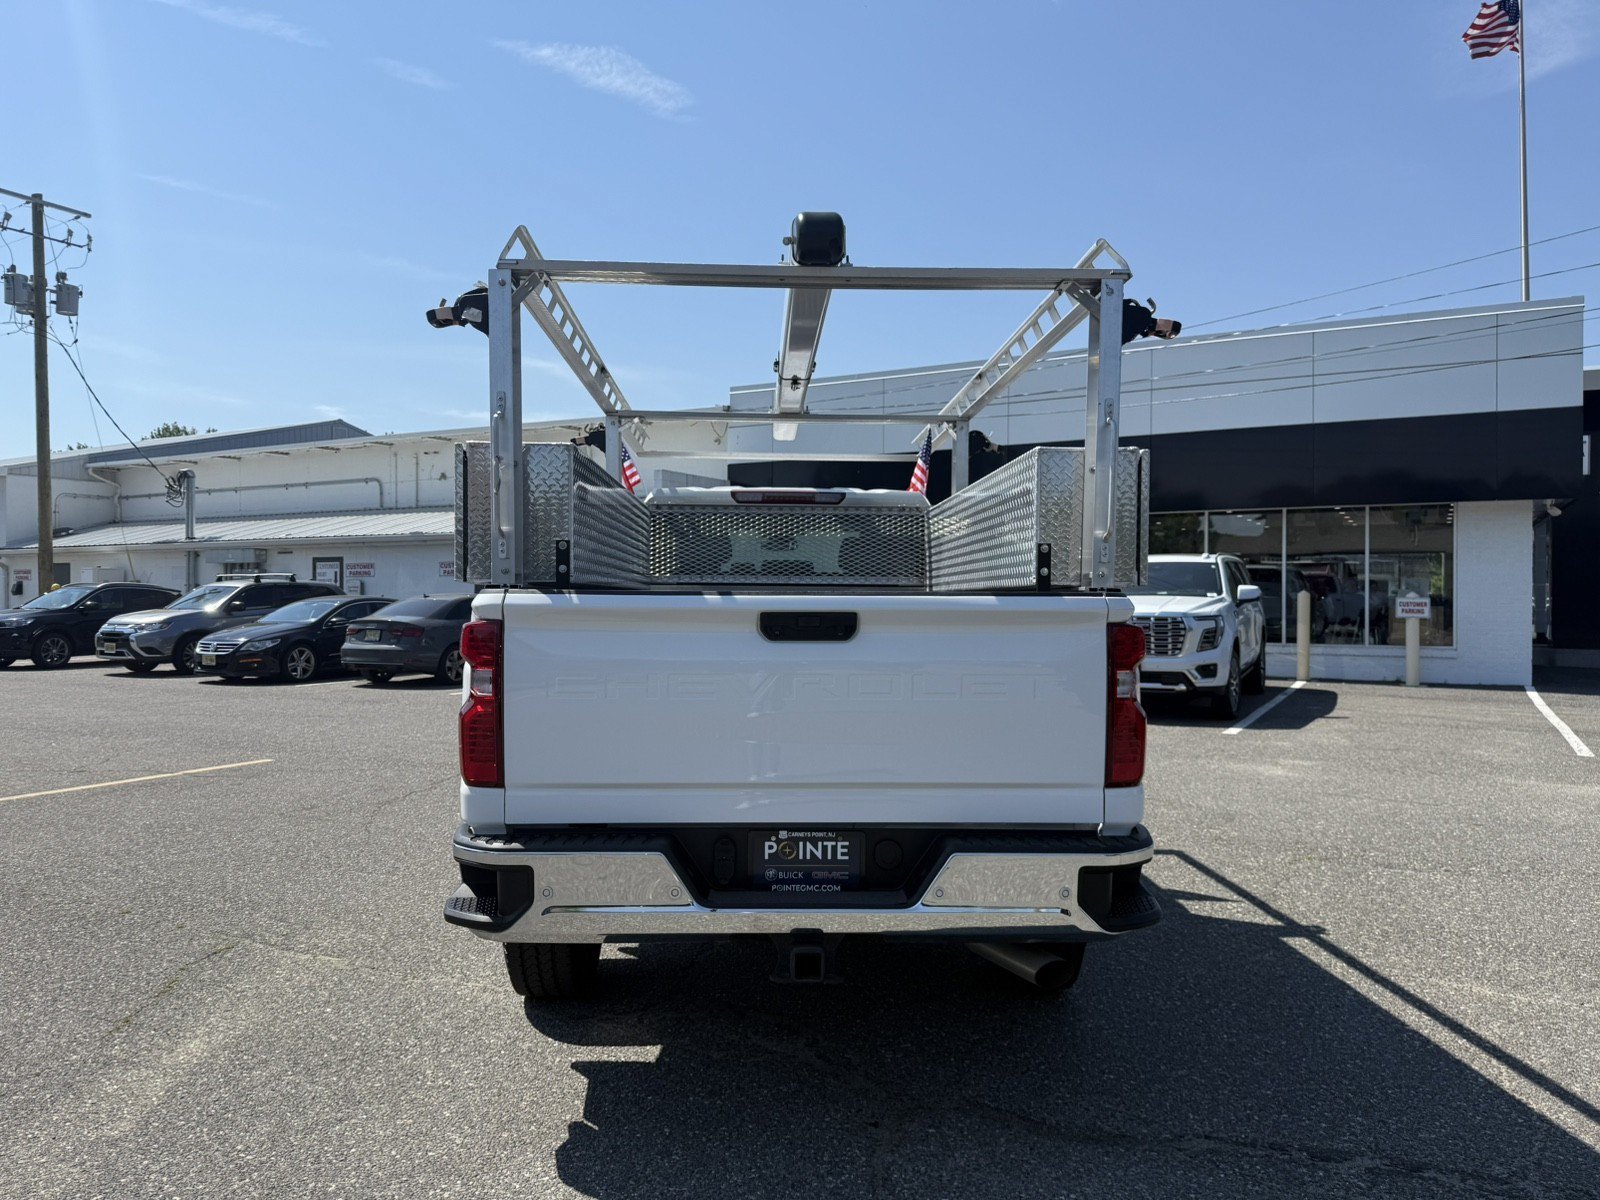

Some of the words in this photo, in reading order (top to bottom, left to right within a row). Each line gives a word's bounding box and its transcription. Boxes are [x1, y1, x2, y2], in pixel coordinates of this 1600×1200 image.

[546, 672, 1066, 701] CHEVROLET
[765, 841, 849, 860] POINTE
[778, 871, 804, 879] BUICK
[812, 871, 849, 879] GMC
